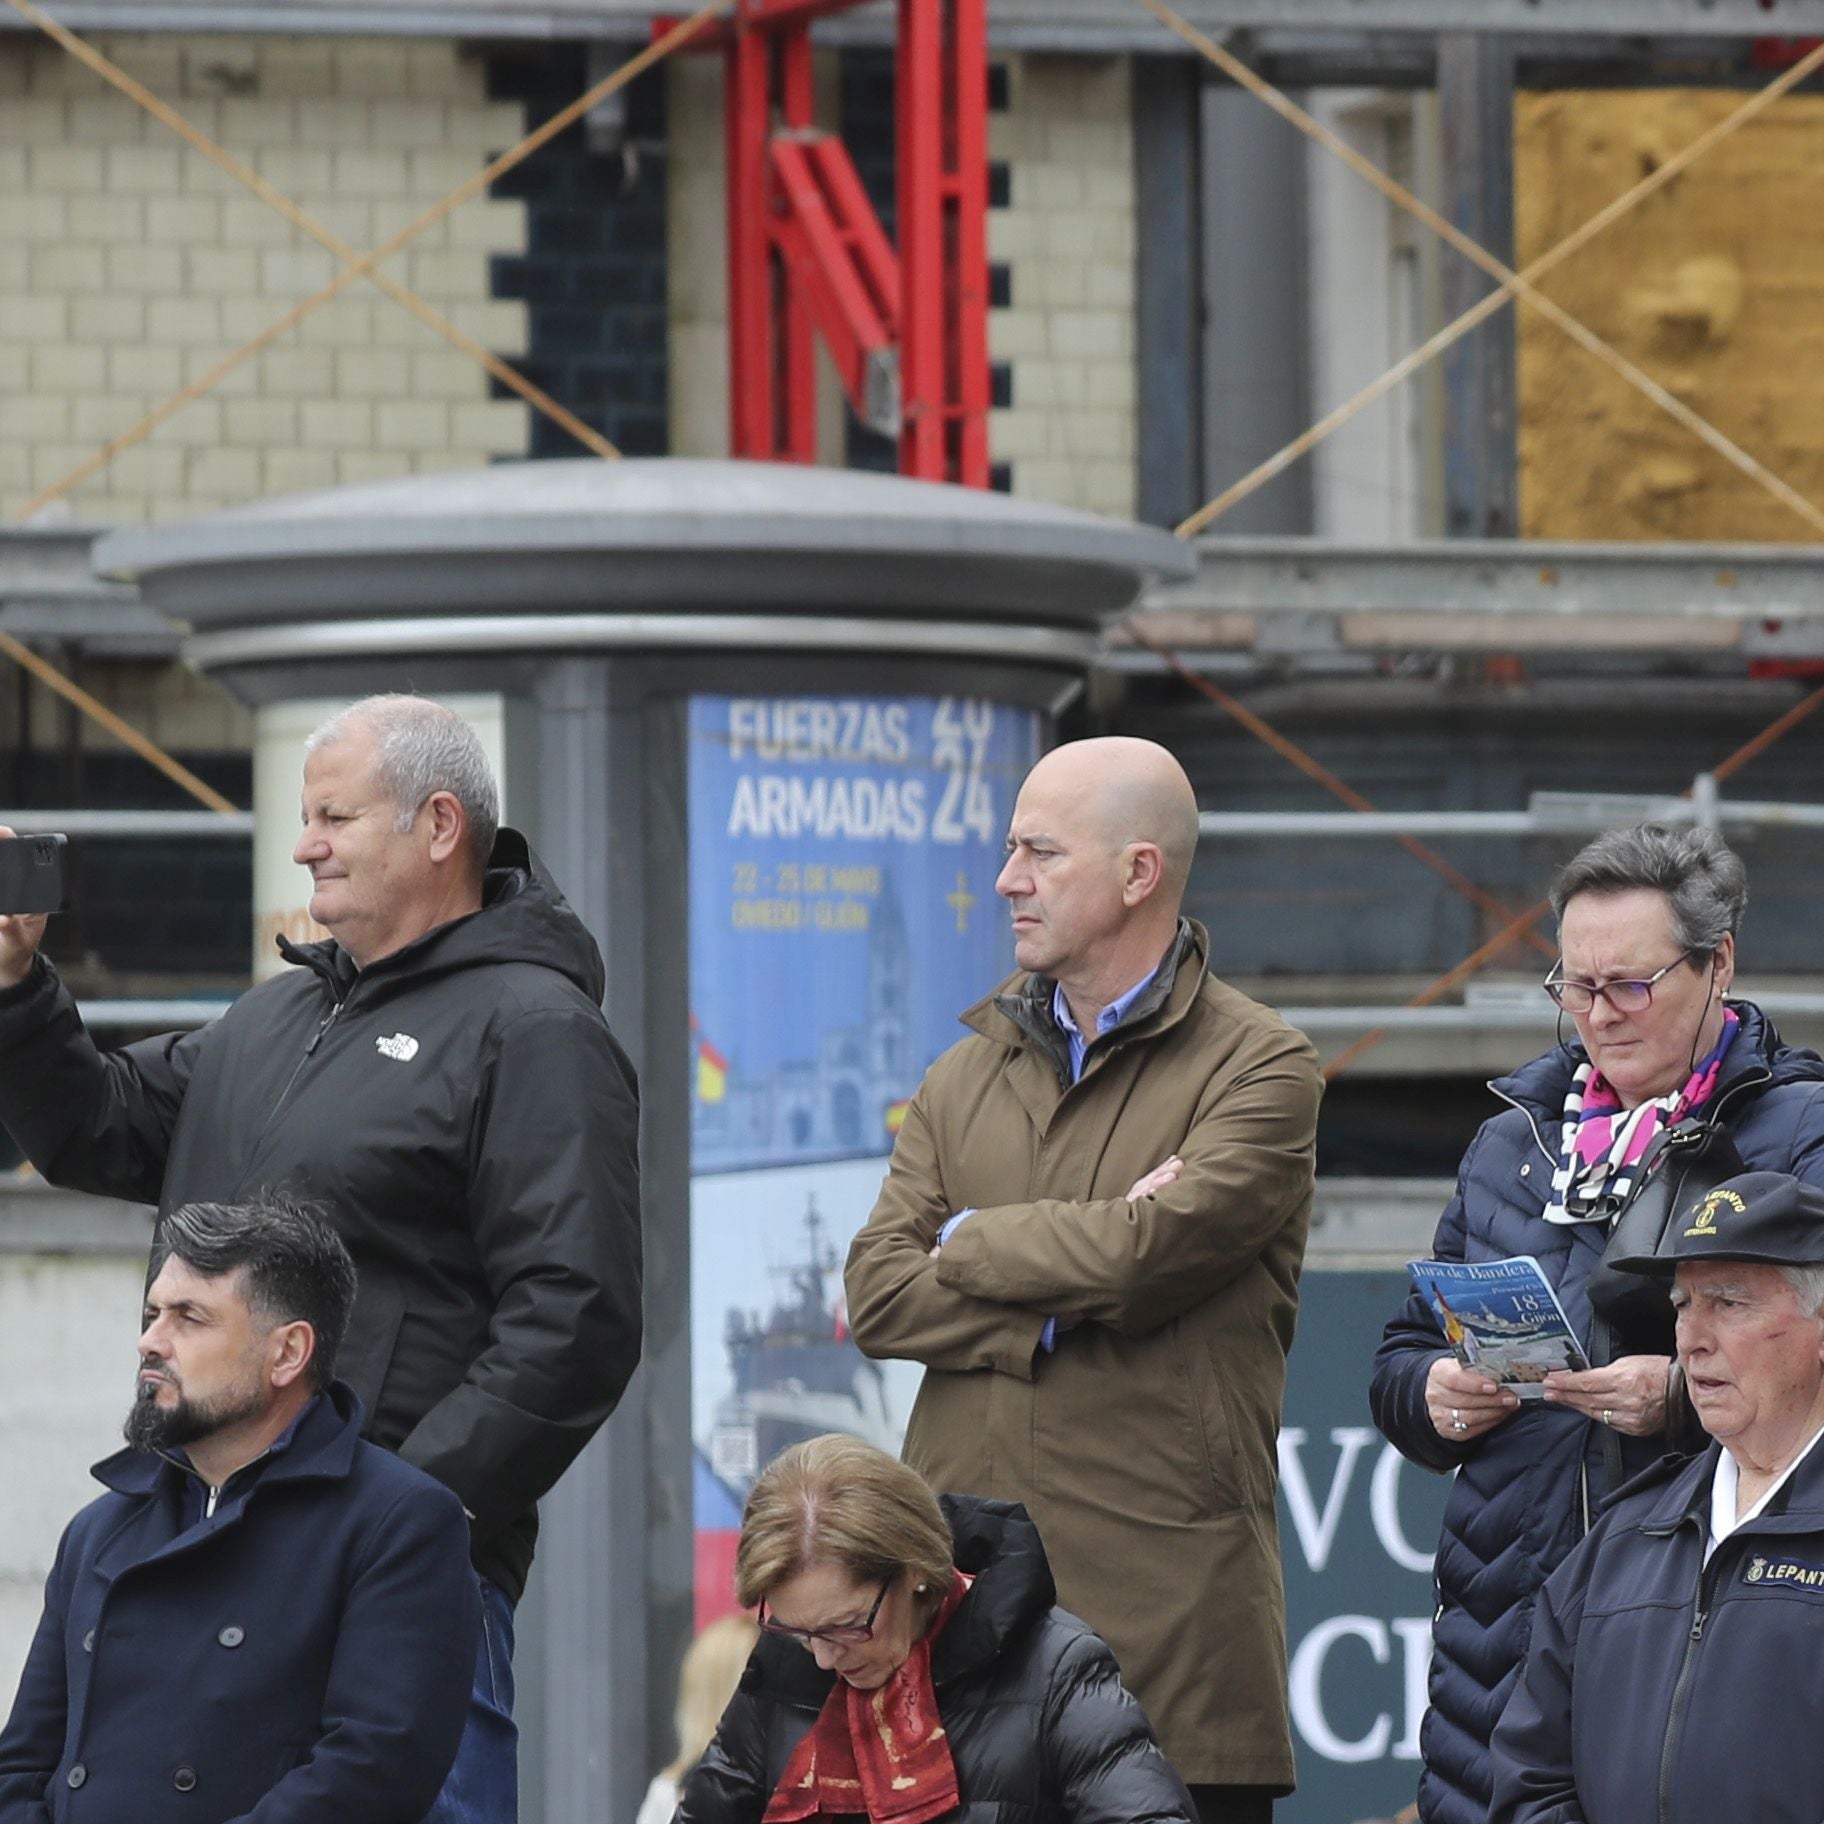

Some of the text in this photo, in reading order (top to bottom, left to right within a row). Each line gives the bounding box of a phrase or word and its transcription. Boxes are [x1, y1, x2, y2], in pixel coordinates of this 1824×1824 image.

[728, 699, 909, 764] FUERZAS
[726, 775, 928, 842] ARMADAS
[931, 738, 995, 844] 24
[1467, 1263, 1536, 1280] Bandera
[1511, 1294, 1539, 1312] 18
[1521, 1309, 1561, 1325] Gijón
